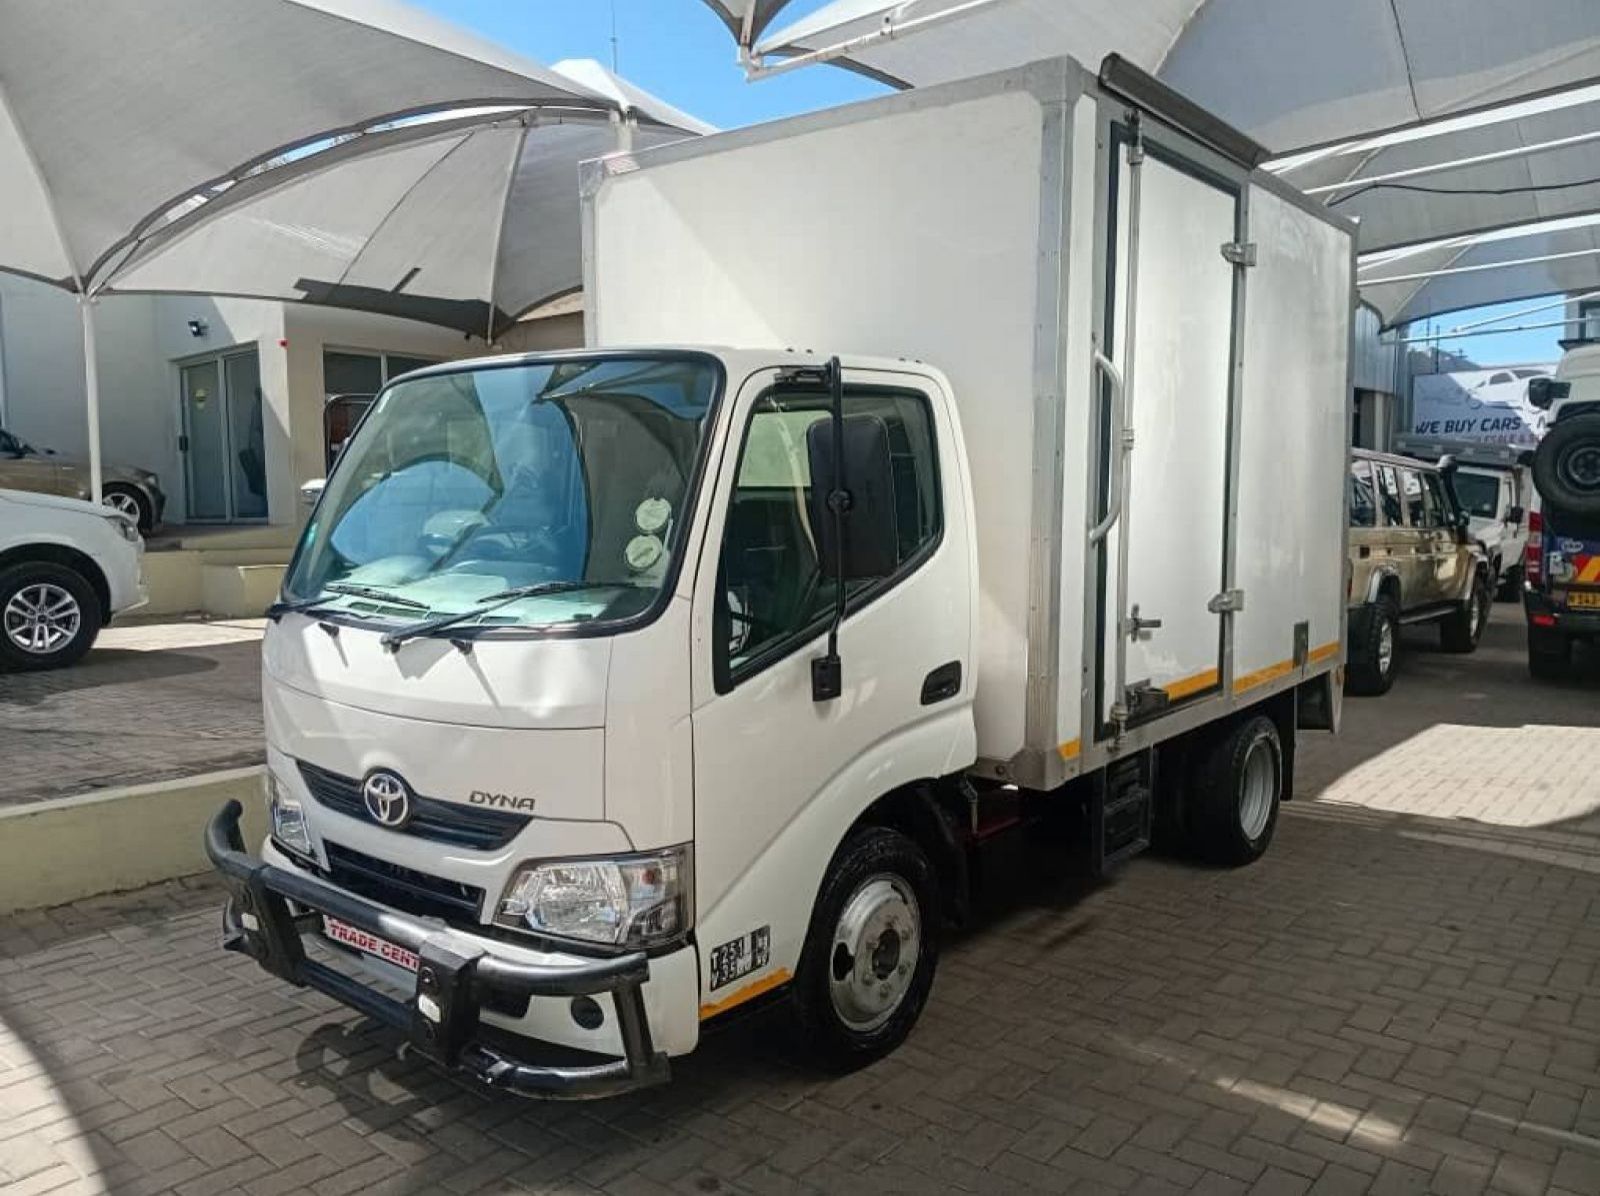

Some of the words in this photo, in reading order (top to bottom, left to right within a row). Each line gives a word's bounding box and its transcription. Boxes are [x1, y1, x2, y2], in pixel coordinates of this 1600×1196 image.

[1415, 421, 1440, 434] WE
[1444, 419, 1477, 433] BUY
[1480, 416, 1523, 432] CARS
[469, 790, 536, 811] DYNA
[329, 923, 378, 952] TRADE
